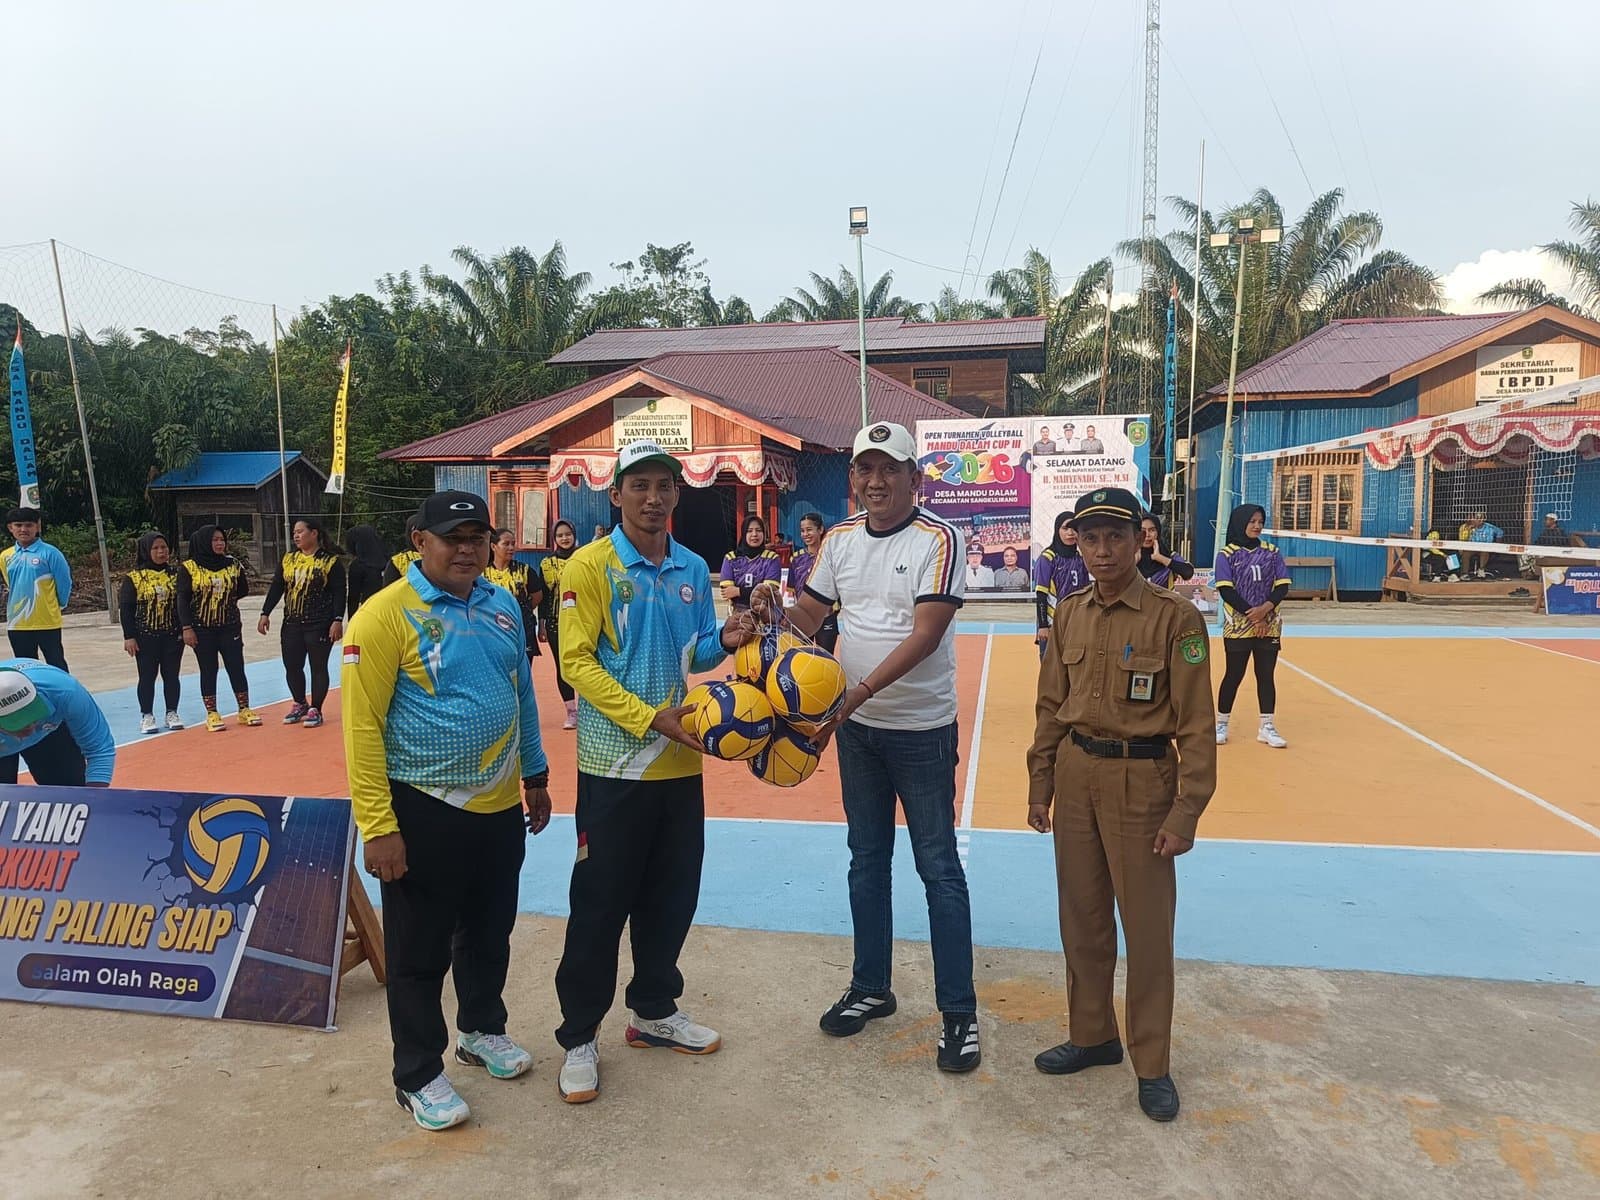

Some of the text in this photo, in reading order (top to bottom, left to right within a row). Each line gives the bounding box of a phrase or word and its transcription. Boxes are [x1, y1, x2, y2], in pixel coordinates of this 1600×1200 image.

[1500, 360, 1554, 368] SEKRETARIAT
[624, 428, 681, 436] KANTOR DESA
[944, 431, 980, 439] TURNAMEN
[981, 430, 1024, 438] VOLLEYBALL
[655, 437, 688, 446] DALAM
[927, 439, 1021, 451] MANDU DALAM CUP III
[941, 452, 1014, 486] 2026
[1046, 458, 1126, 467] SELAMAT DATANG
[935, 490, 955, 498] DESA
[957, 489, 988, 497] MANDU
[1070, 570, 1078, 586] 3
[1251, 564, 1262, 581] 11
[744, 573, 753, 588] 9
[0, 686, 31, 708] ANDALA
[12, 801, 89, 844] YANG
[45, 899, 157, 949] PALING
[158, 906, 235, 954] SIAP
[32, 963, 199, 995] Salam Olah Raga
